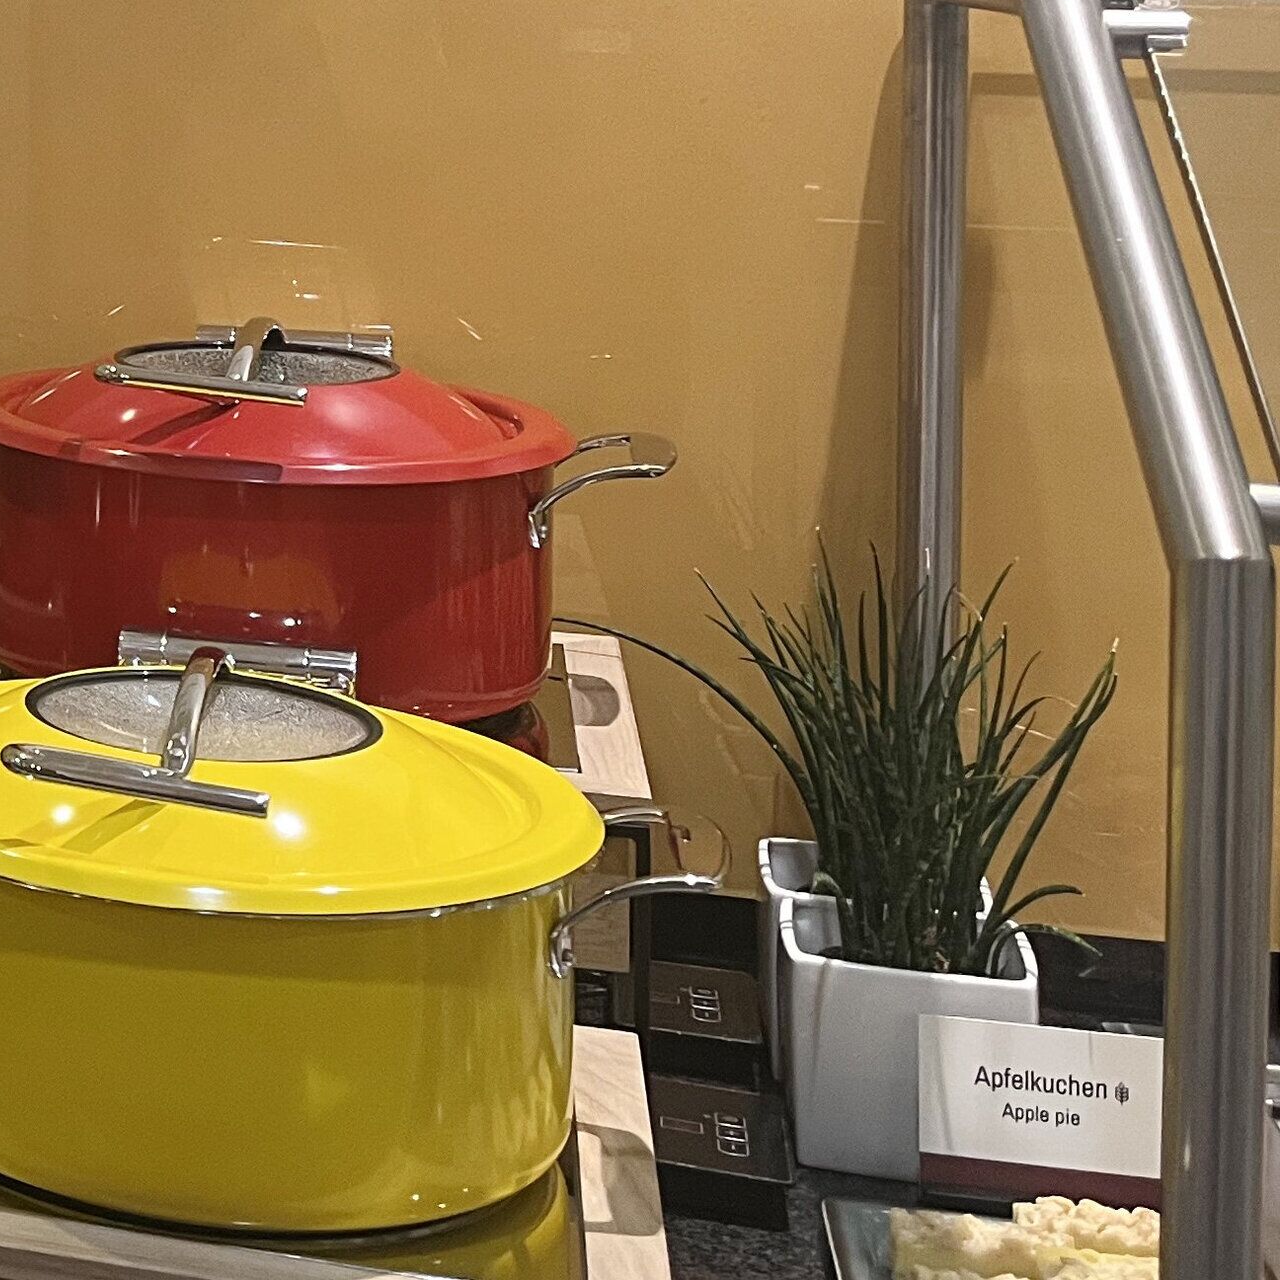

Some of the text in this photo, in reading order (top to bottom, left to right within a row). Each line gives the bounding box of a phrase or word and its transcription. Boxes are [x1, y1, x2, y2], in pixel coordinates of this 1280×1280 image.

[974, 1065, 1108, 1100] Apfelkuchen
[1001, 1102, 1081, 1128] Apple pie
